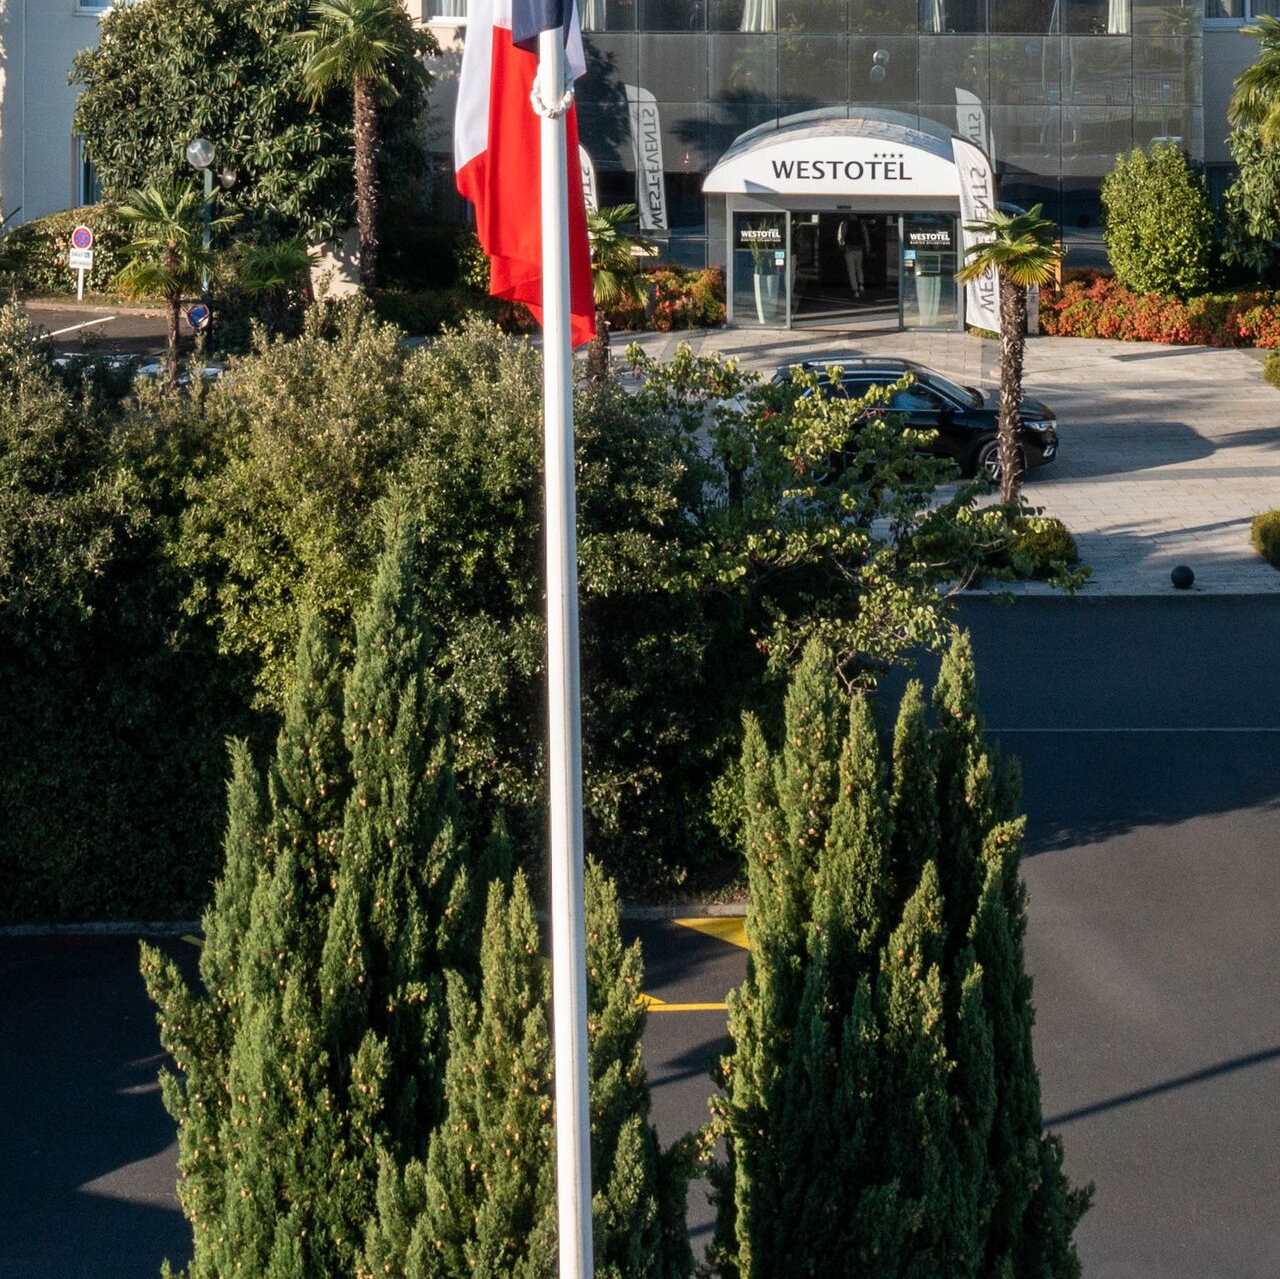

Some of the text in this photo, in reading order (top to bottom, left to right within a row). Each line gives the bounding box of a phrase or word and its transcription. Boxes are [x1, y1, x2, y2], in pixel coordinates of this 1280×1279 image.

[772, 160, 912, 180] WESTOTEL
[741, 230, 781, 238] WESTOTEL
[910, 233, 950, 241] WESTOTEL
